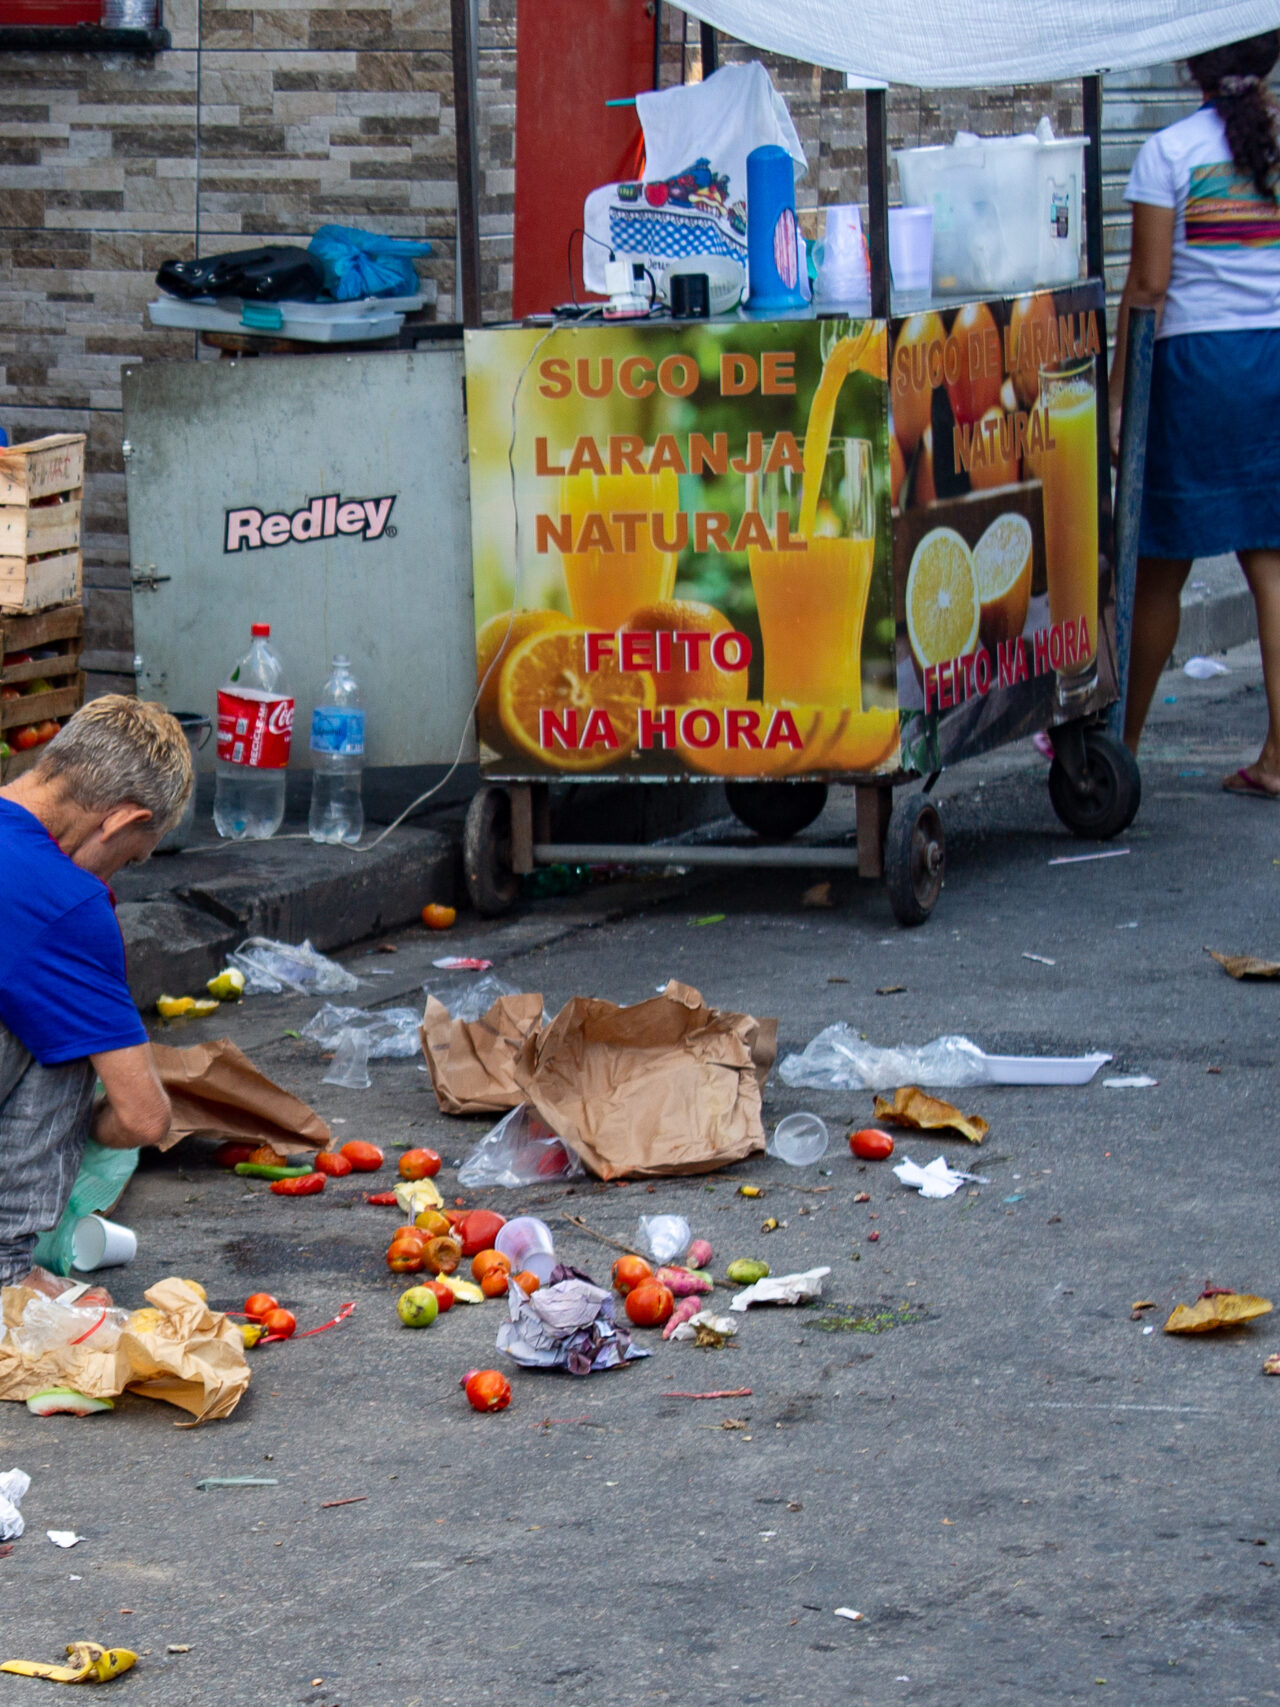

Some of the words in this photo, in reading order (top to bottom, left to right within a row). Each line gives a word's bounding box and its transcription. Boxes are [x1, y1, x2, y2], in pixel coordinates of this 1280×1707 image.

[538, 354, 700, 400] SUCO
[719, 352, 797, 396] DE
[895, 339, 960, 397] SUCO
[968, 327, 998, 380] DE
[1004, 309, 1101, 372] LARANJA
[534, 432, 806, 477] LARANJA
[952, 406, 1057, 475] NATURAL
[535, 511, 808, 554] NATURAL
[584, 631, 753, 673] FEITO
[922, 651, 992, 715] FEITO
[996, 636, 1028, 689] NA
[1033, 615, 1091, 670] HORA
[249, 702, 267, 767] RECICLE-M
[539, 708, 620, 750] NA
[637, 708, 804, 749] HORA
